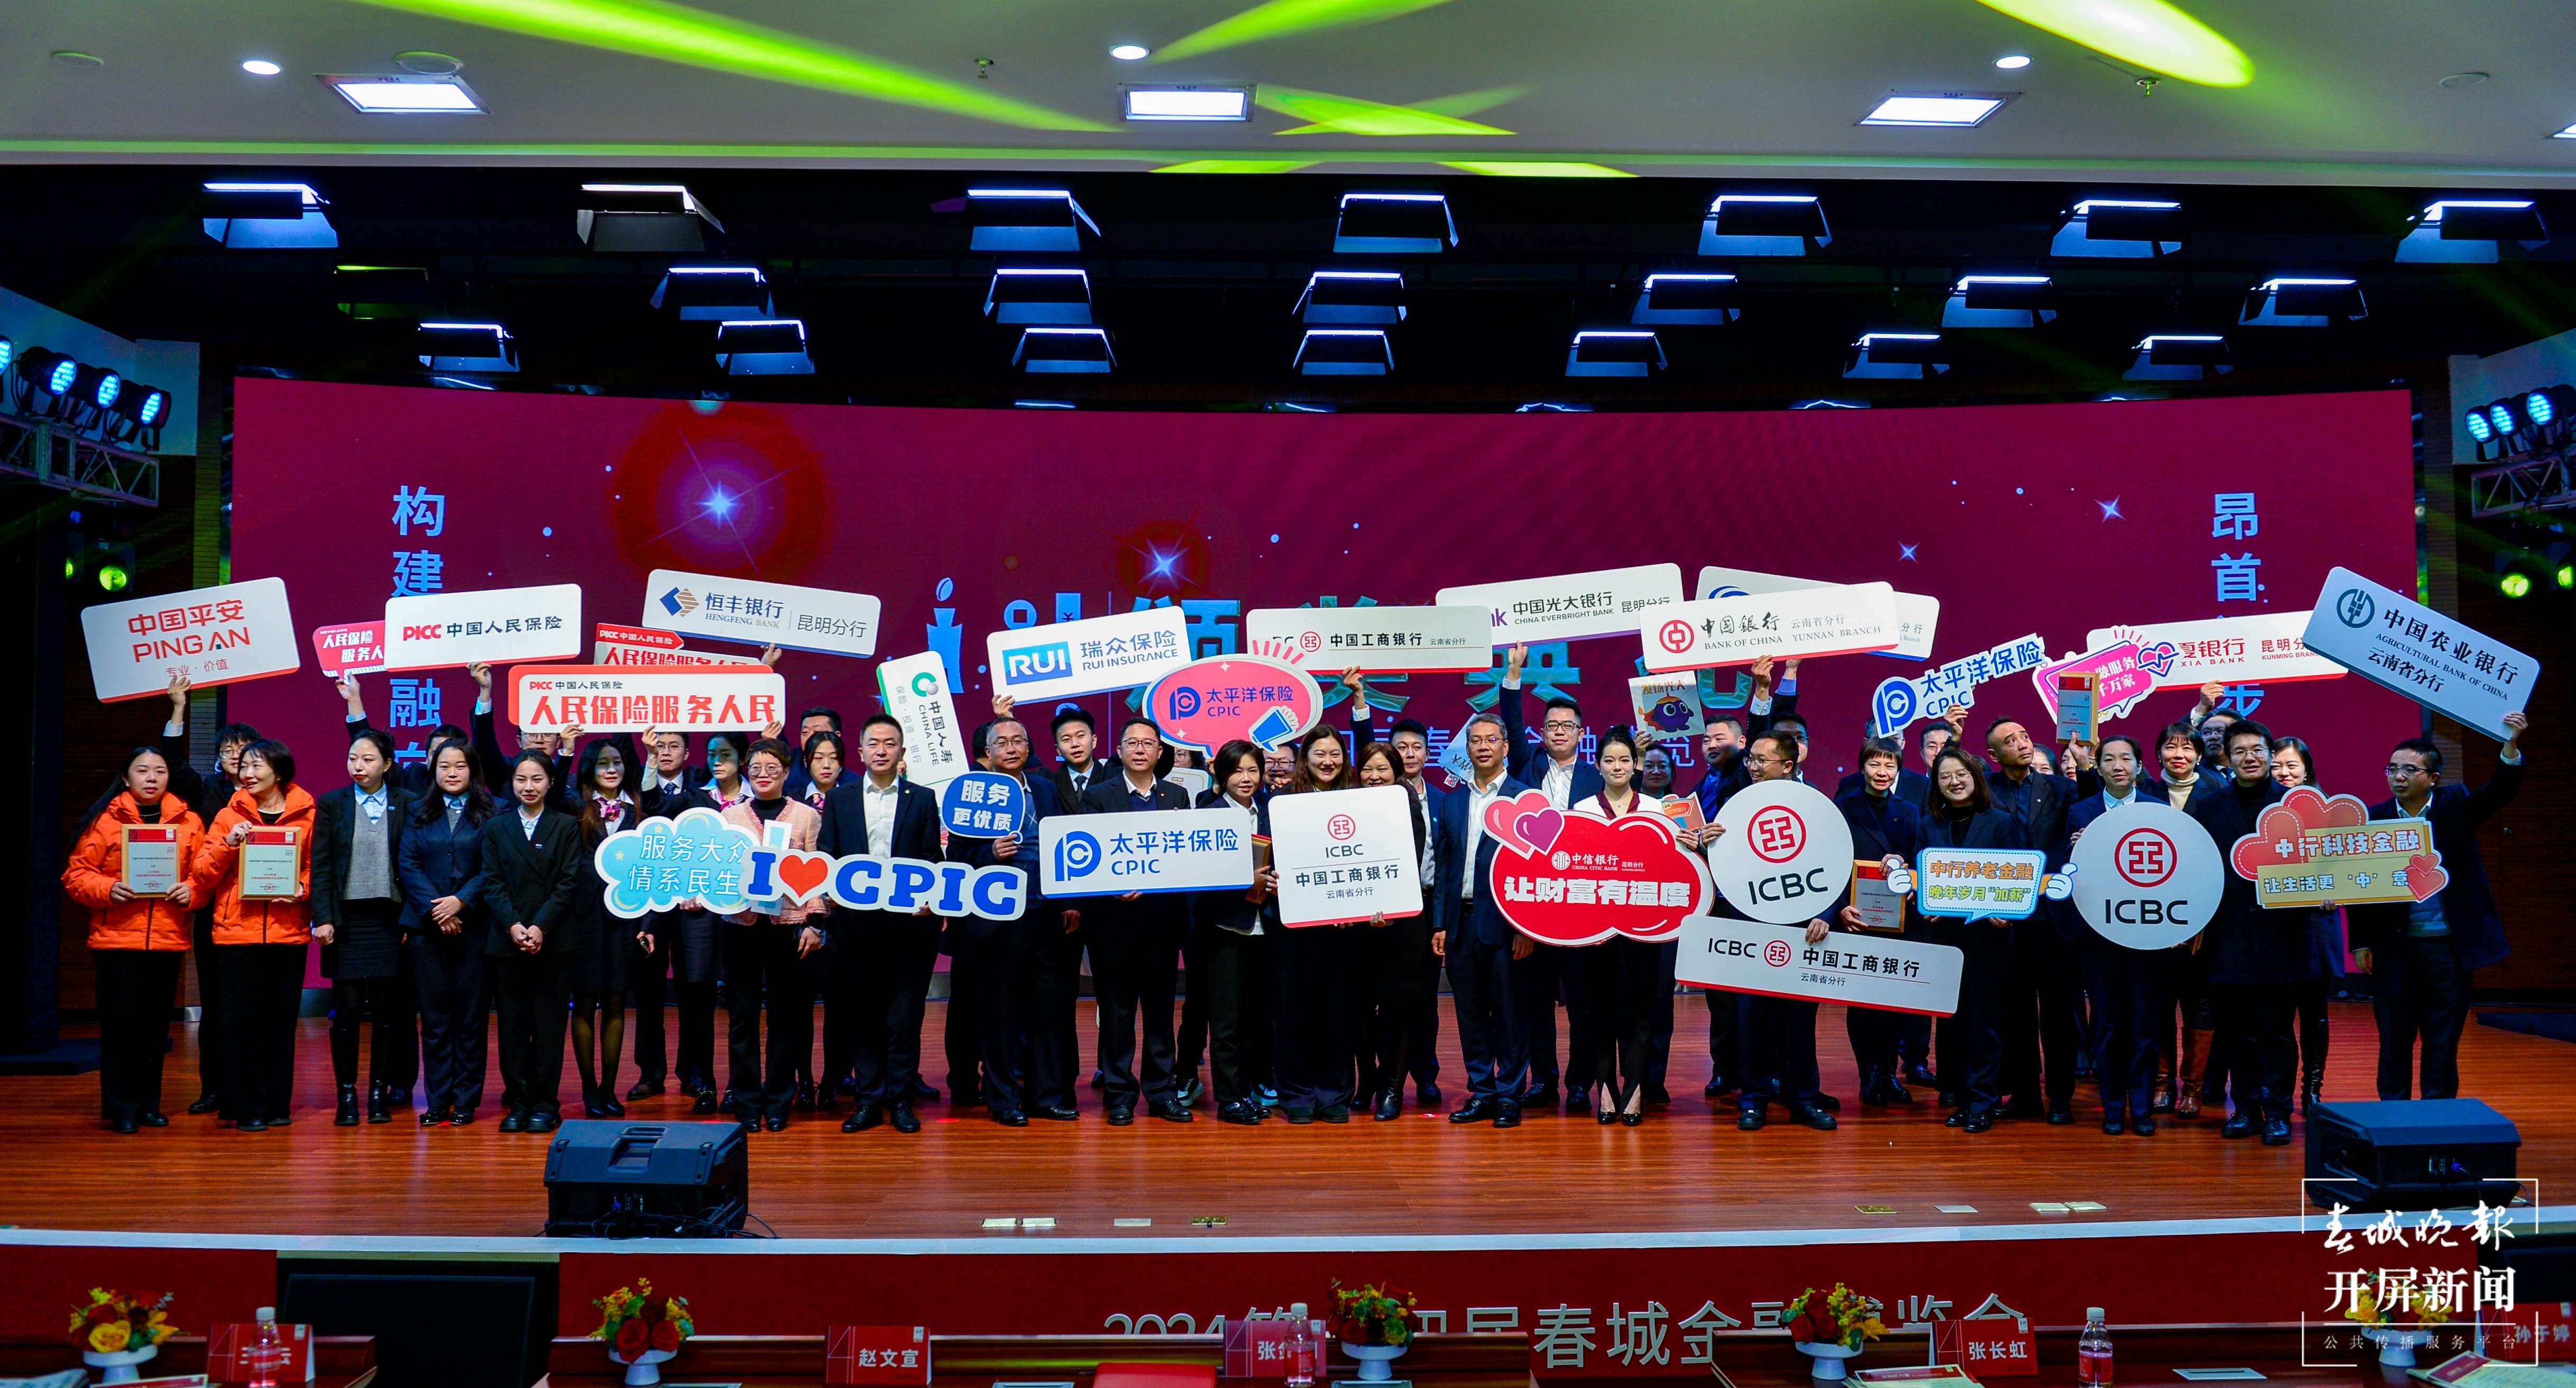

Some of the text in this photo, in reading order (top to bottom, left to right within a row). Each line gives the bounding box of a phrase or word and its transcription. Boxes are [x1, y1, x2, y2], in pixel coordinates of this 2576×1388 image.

[705, 592, 784, 619] 恒丰银行
[1513, 591, 1613, 615] 中国光大银行
[2211, 493, 2265, 717] 昂首步
[128, 600, 244, 636] 中国平安
[403, 615, 563, 641] PICC 中国人民保险
[705, 613, 780, 629] HENGFENG BANK
[797, 614, 867, 638] 昆明分行
[1514, 617, 1540, 625] CHINA
[1542, 611, 1590, 622] EVERBRIGHT
[1790, 614, 1845, 629] 云南省分行
[322, 630, 373, 648] 人民保险
[1081, 630, 1177, 659] 瑞众保险
[1330, 632, 1422, 647] 中国工商银行
[1705, 640, 1731, 650] BANK
[1750, 636, 1782, 645] CHINA
[1792, 631, 1834, 641] YUNNAN
[1840, 626, 1880, 637] BRANCH
[2178, 638, 2245, 658] 夏银行
[2261, 637, 2304, 652] 昆明分
[2384, 609, 2518, 684] 中国农业银行
[342, 645, 384, 663] 服务人
[1008, 649, 1066, 677] RUI
[1083, 649, 1178, 671] RUI INSURANCE
[1920, 639, 2044, 694] 太平洋保险
[2085, 656, 2136, 679] 融服务
[2369, 647, 2444, 693] 云南省分行
[2376, 634, 2507, 700] AGRICULTURAL BANK OF CHINA
[530, 681, 623, 690] PICC 中国人民保险
[1207, 685, 1293, 703] 太平洋保险
[2097, 674, 2136, 697] 千万家
[530, 695, 775, 725] 人民保险服务人民
[1208, 706, 1240, 717] CPIC
[1926, 688, 1970, 716] CPIC
[918, 704, 939, 766] CHINA LIFE
[928, 701, 953, 764] 中国人寿
[961, 780, 1011, 807] 服务
[953, 809, 1013, 832] 更优质
[640, 834, 749, 863] 服务大众
[1110, 829, 1239, 855] 太平洋保险
[1326, 844, 1364, 858] ICBC
[2275, 829, 2421, 858] 中行科技金融
[1111, 859, 1160, 875] CPIC
[1572, 853, 1619, 866] 中信银行
[1929, 860, 2034, 881] 中行养老金融
[629, 865, 739, 895] 情系民生
[1295, 863, 1400, 887] 中国工商银行
[1748, 867, 1828, 905] ICBC
[835, 860, 1018, 915] CPIC
[1326, 886, 1374, 899] 云南省分行
[1504, 877, 1690, 907] 让财富有温度
[2105, 899, 2189, 925] ICBC
[1708, 937, 1756, 959] ICBC
[1802, 948, 1920, 978] 中国工商银行
[1801, 973, 1845, 987] 云南省分行
[859, 1348, 919, 1367] 赵文宣
[1968, 1340, 2027, 1361] 张长虹
